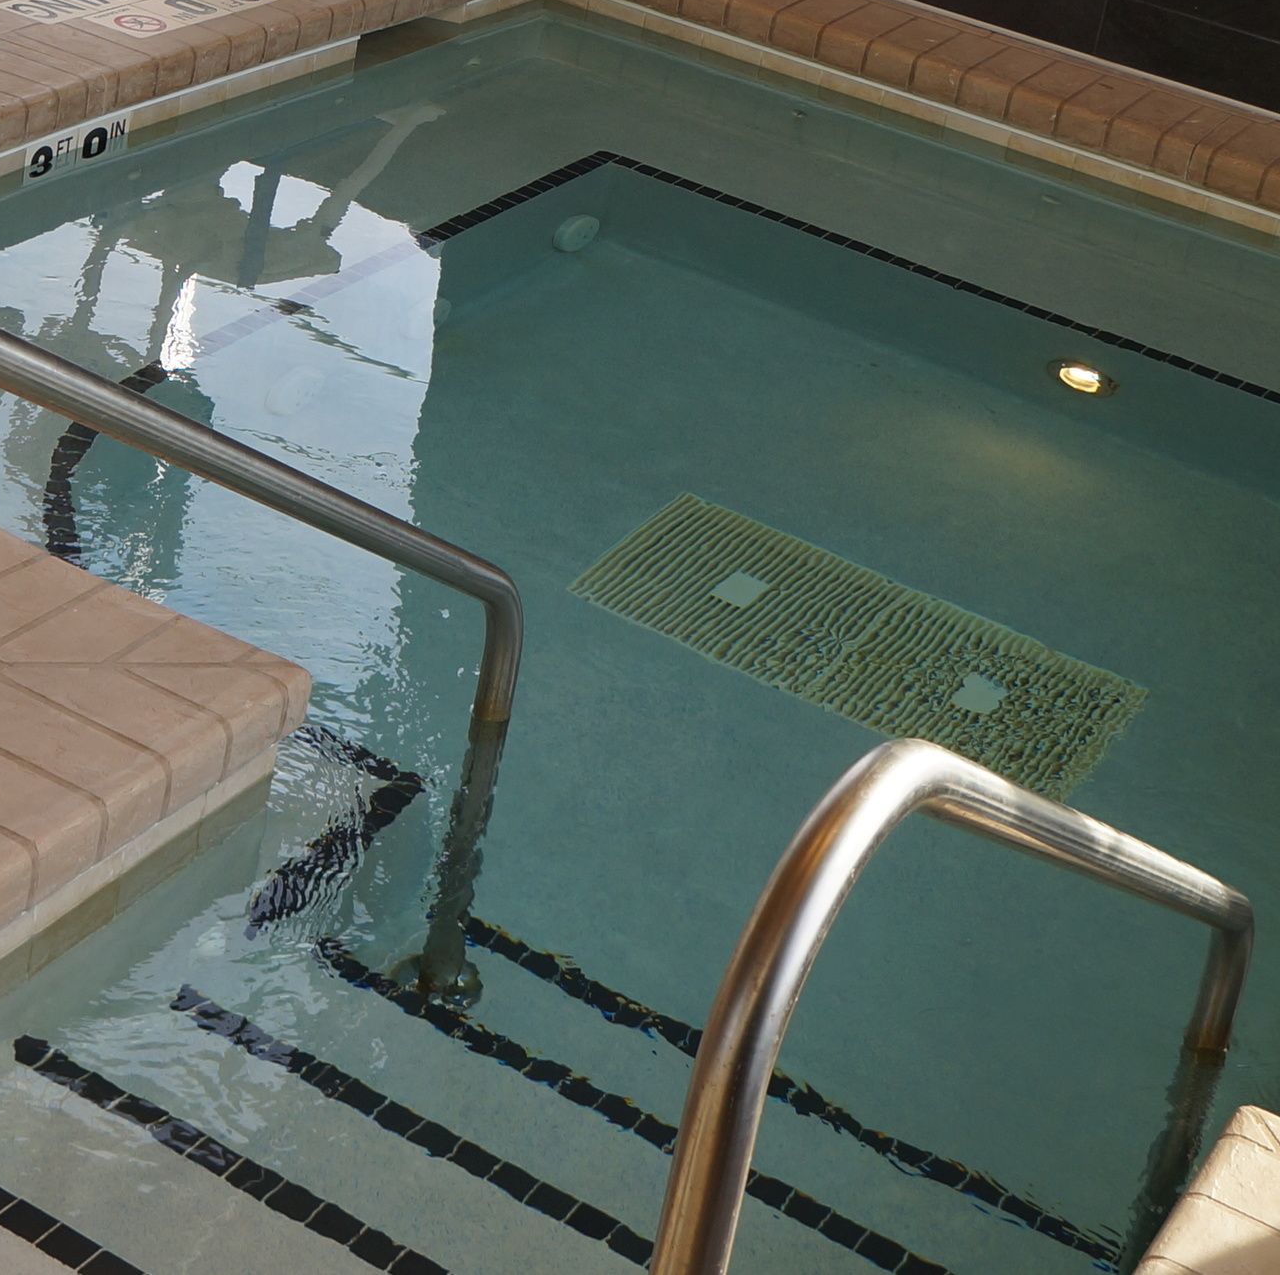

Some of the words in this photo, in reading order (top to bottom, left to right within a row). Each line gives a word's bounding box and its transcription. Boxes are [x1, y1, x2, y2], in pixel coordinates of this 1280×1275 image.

[29, 145, 53, 178] 3
[56, 136, 74, 158] FT
[109, 119, 126, 140] IN
